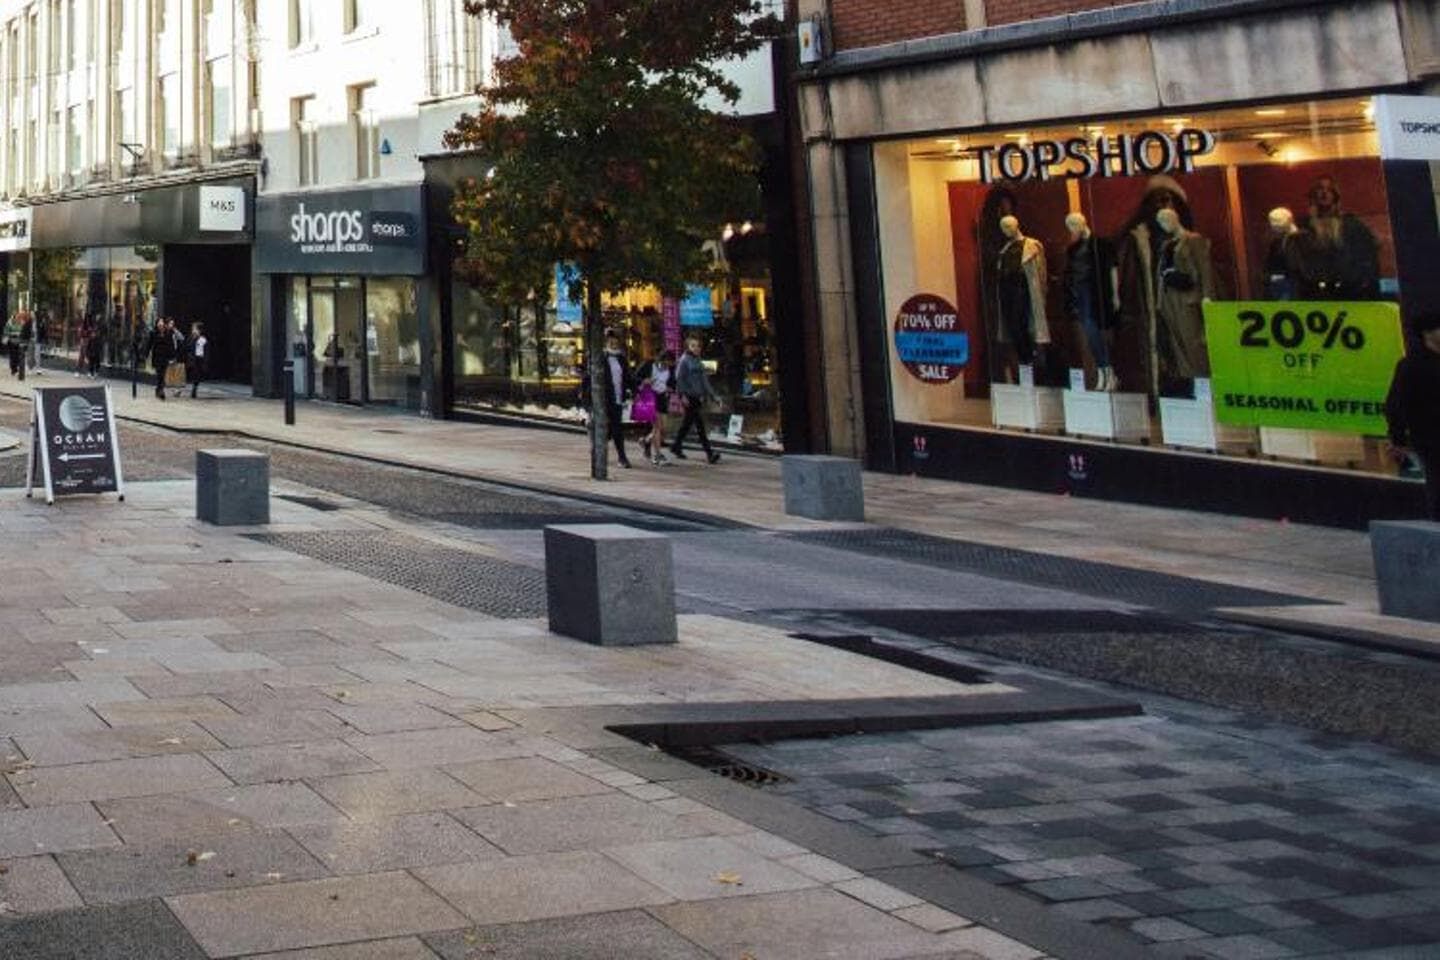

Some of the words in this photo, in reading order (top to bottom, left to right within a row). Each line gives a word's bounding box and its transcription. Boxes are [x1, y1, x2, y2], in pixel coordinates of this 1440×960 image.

[970, 128, 1215, 183] TOPSHOP
[210, 200, 235, 211] M&S
[291, 202, 363, 251] sharps
[372, 222, 406, 236] sharps
[900, 312, 932, 329] 70%
[934, 314, 957, 328] OFF
[1237, 310, 1365, 350] 20%
[1284, 353, 1324, 368] OFF
[918, 364, 950, 379] SALE
[1224, 393, 1319, 412] SEASONAL
[53, 433, 105, 444] OCEAN
